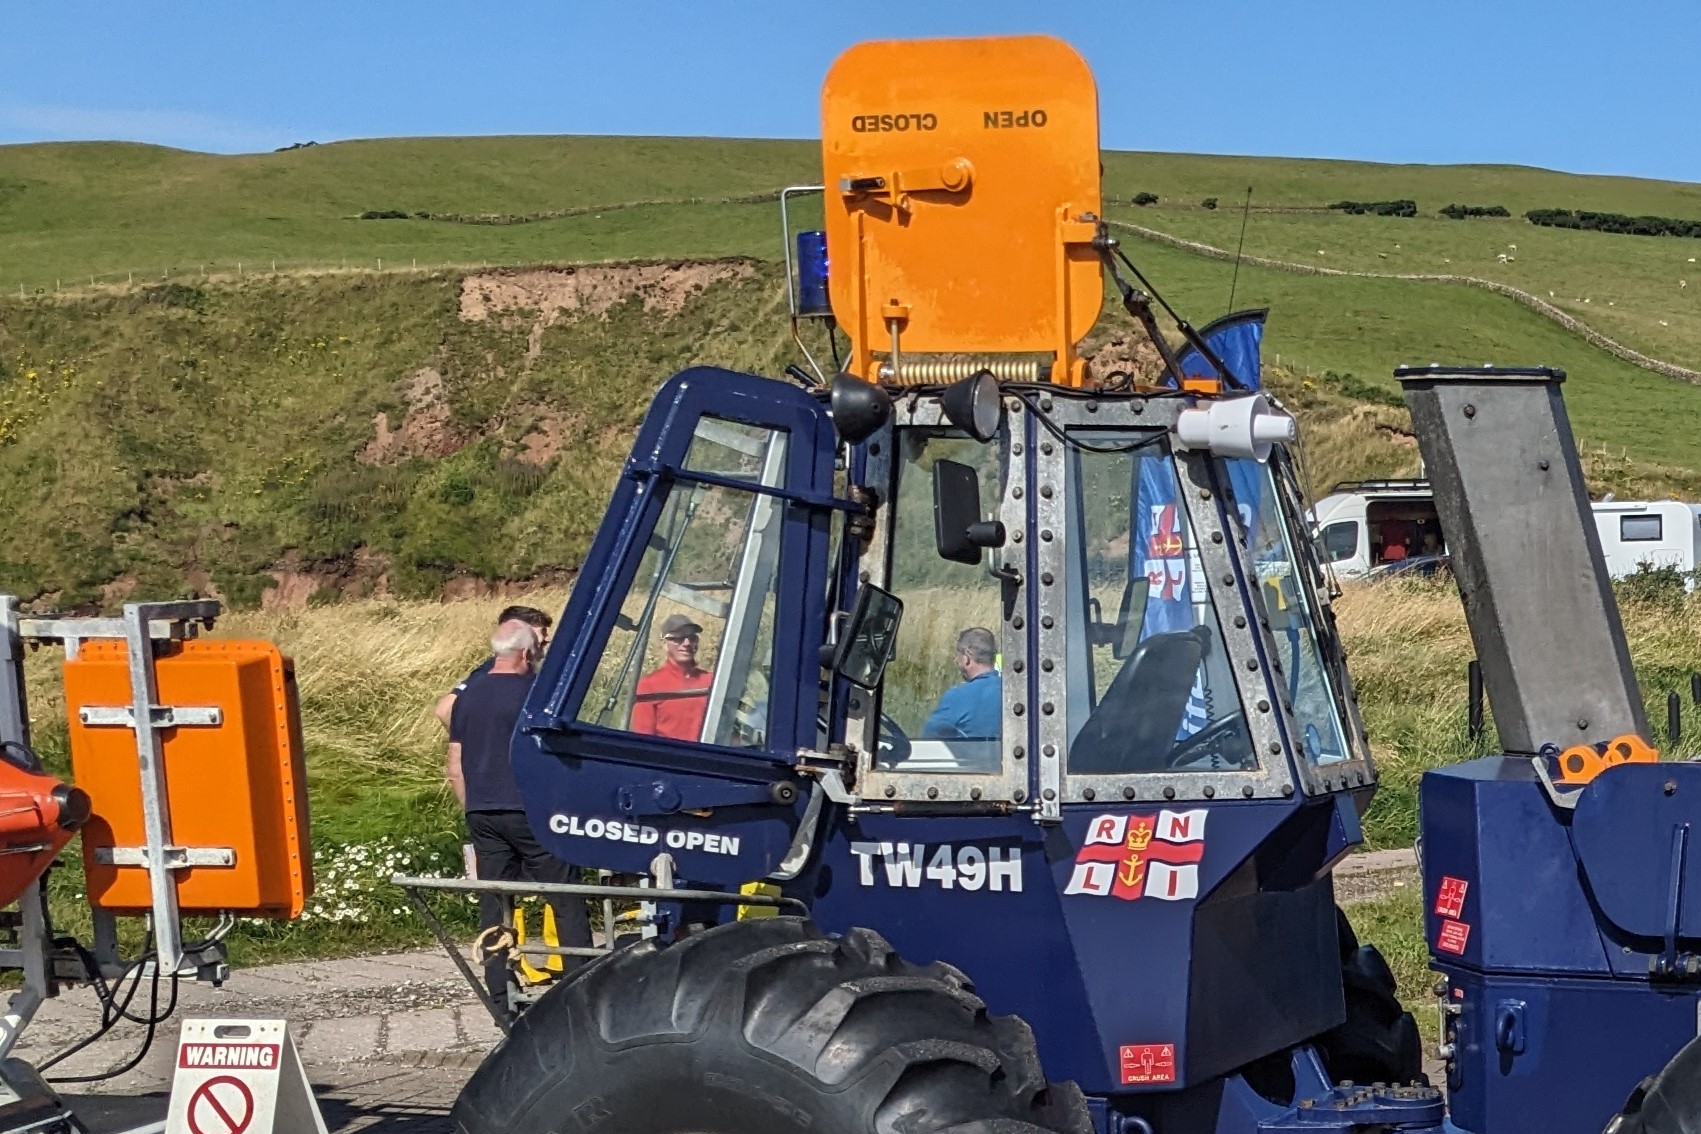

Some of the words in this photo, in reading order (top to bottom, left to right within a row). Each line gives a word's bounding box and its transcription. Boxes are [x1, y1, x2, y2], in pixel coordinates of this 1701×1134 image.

[852, 113, 938, 133] CLOSED
[983, 109, 1048, 130] OPEN
[549, 814, 659, 845] CLOSED
[666, 829, 740, 856] OPEN
[850, 841, 1023, 893] TW49H
[186, 1046, 273, 1067] WARNING
[1152, 1073, 1170, 1081] AREA
